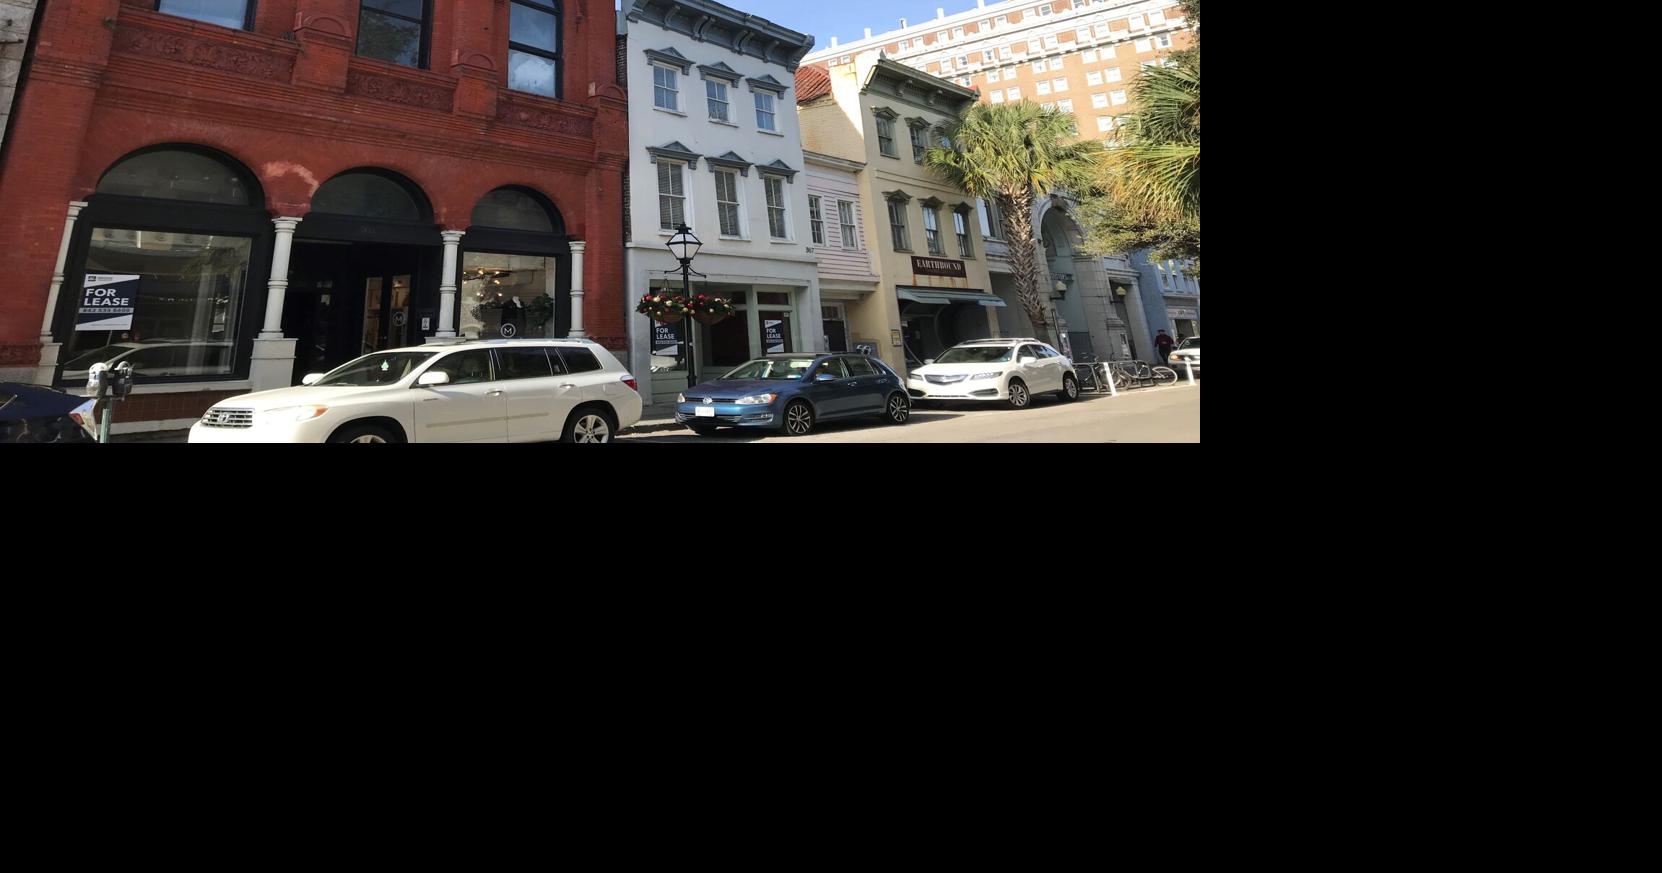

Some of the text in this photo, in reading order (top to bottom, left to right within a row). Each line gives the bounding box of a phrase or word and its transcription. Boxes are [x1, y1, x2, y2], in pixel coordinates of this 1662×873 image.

[916, 259, 962, 270] EARTHBOUND
[85, 288, 117, 297] FOR
[83, 297, 130, 306] LEASE
